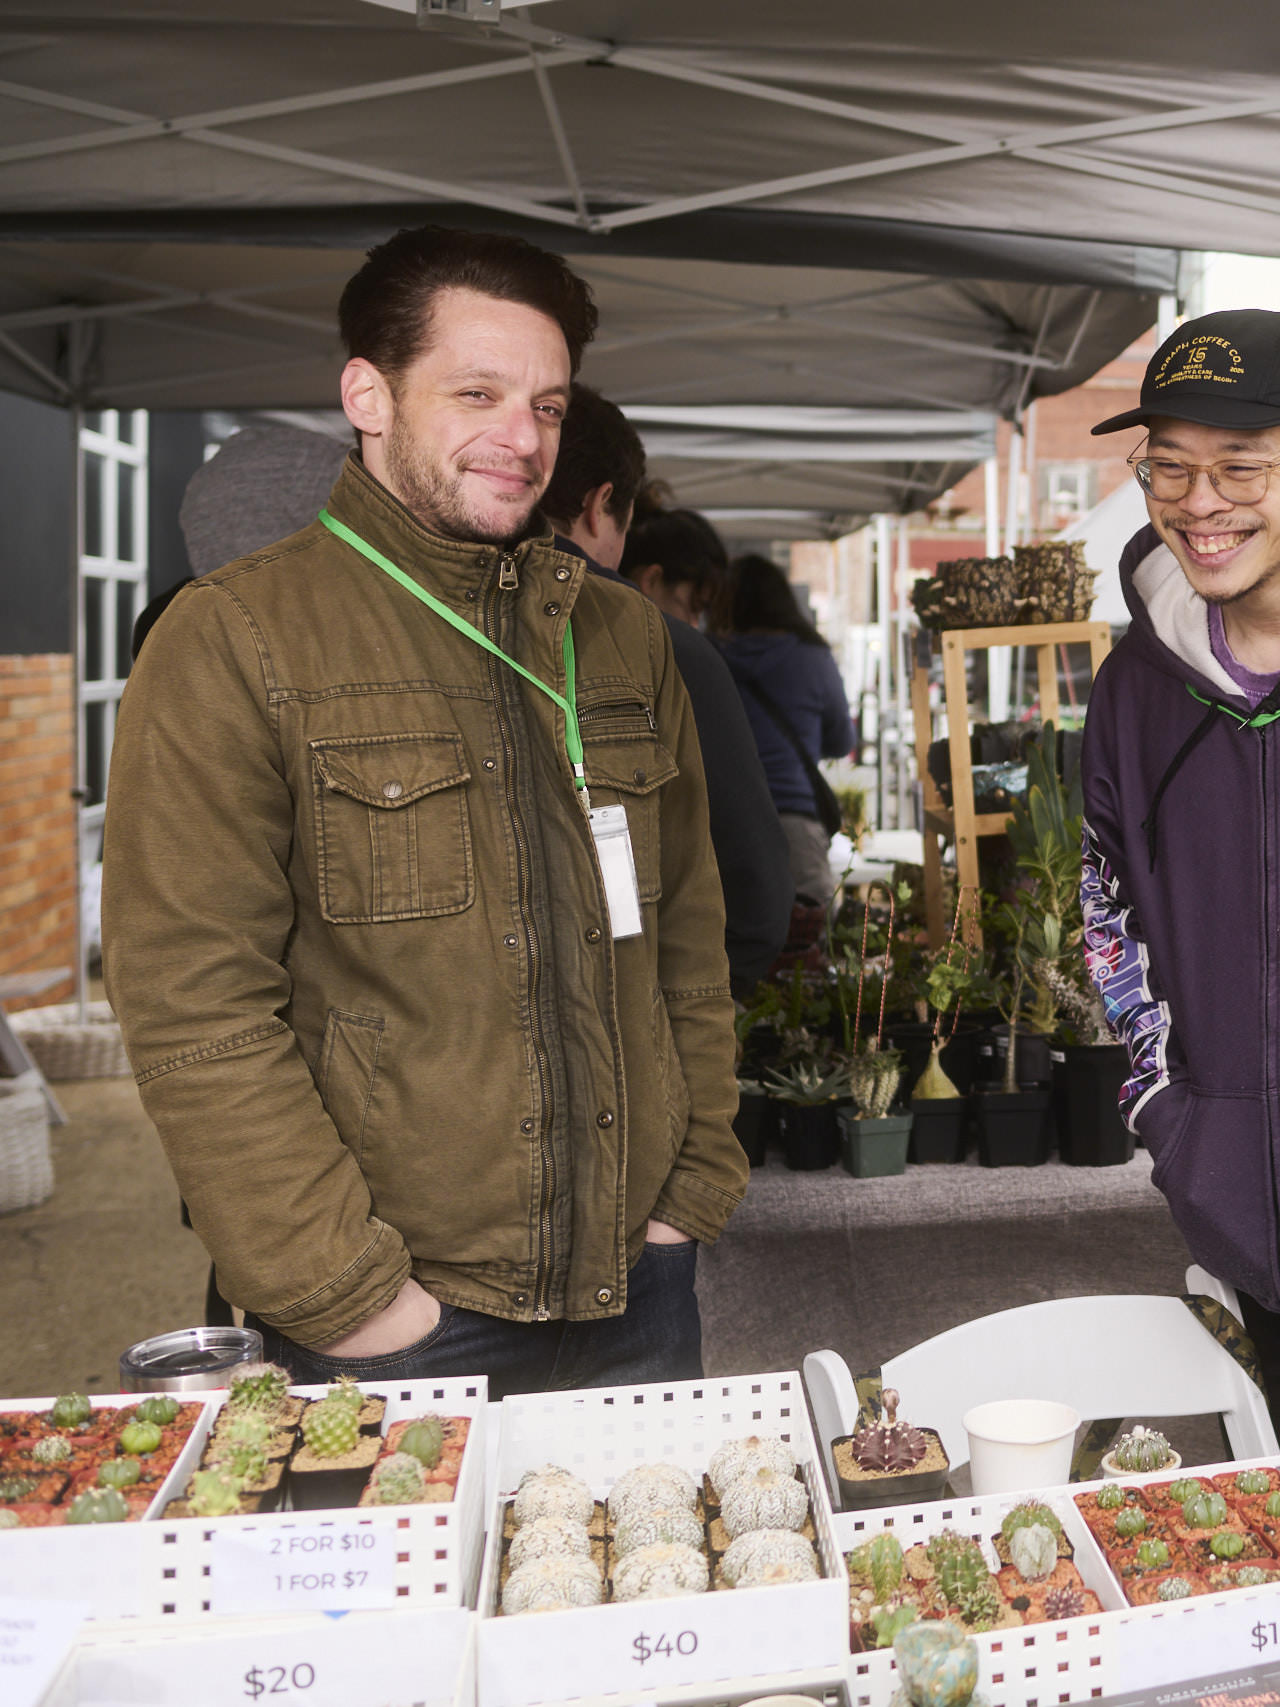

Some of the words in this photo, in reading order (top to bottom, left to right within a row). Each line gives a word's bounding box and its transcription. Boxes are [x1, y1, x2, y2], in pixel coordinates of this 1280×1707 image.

[1191, 336, 1232, 349] COFFEE
[1188, 346, 1209, 364] 15
[270, 1537, 282, 1554] 2
[288, 1535, 334, 1553] FOR
[340, 1532, 376, 1551] $10
[275, 1574, 282, 1591] 1
[289, 1572, 337, 1590] FOR
[343, 1568, 369, 1588] $7
[631, 1629, 699, 1666] $40
[243, 1662, 316, 1701] $20
